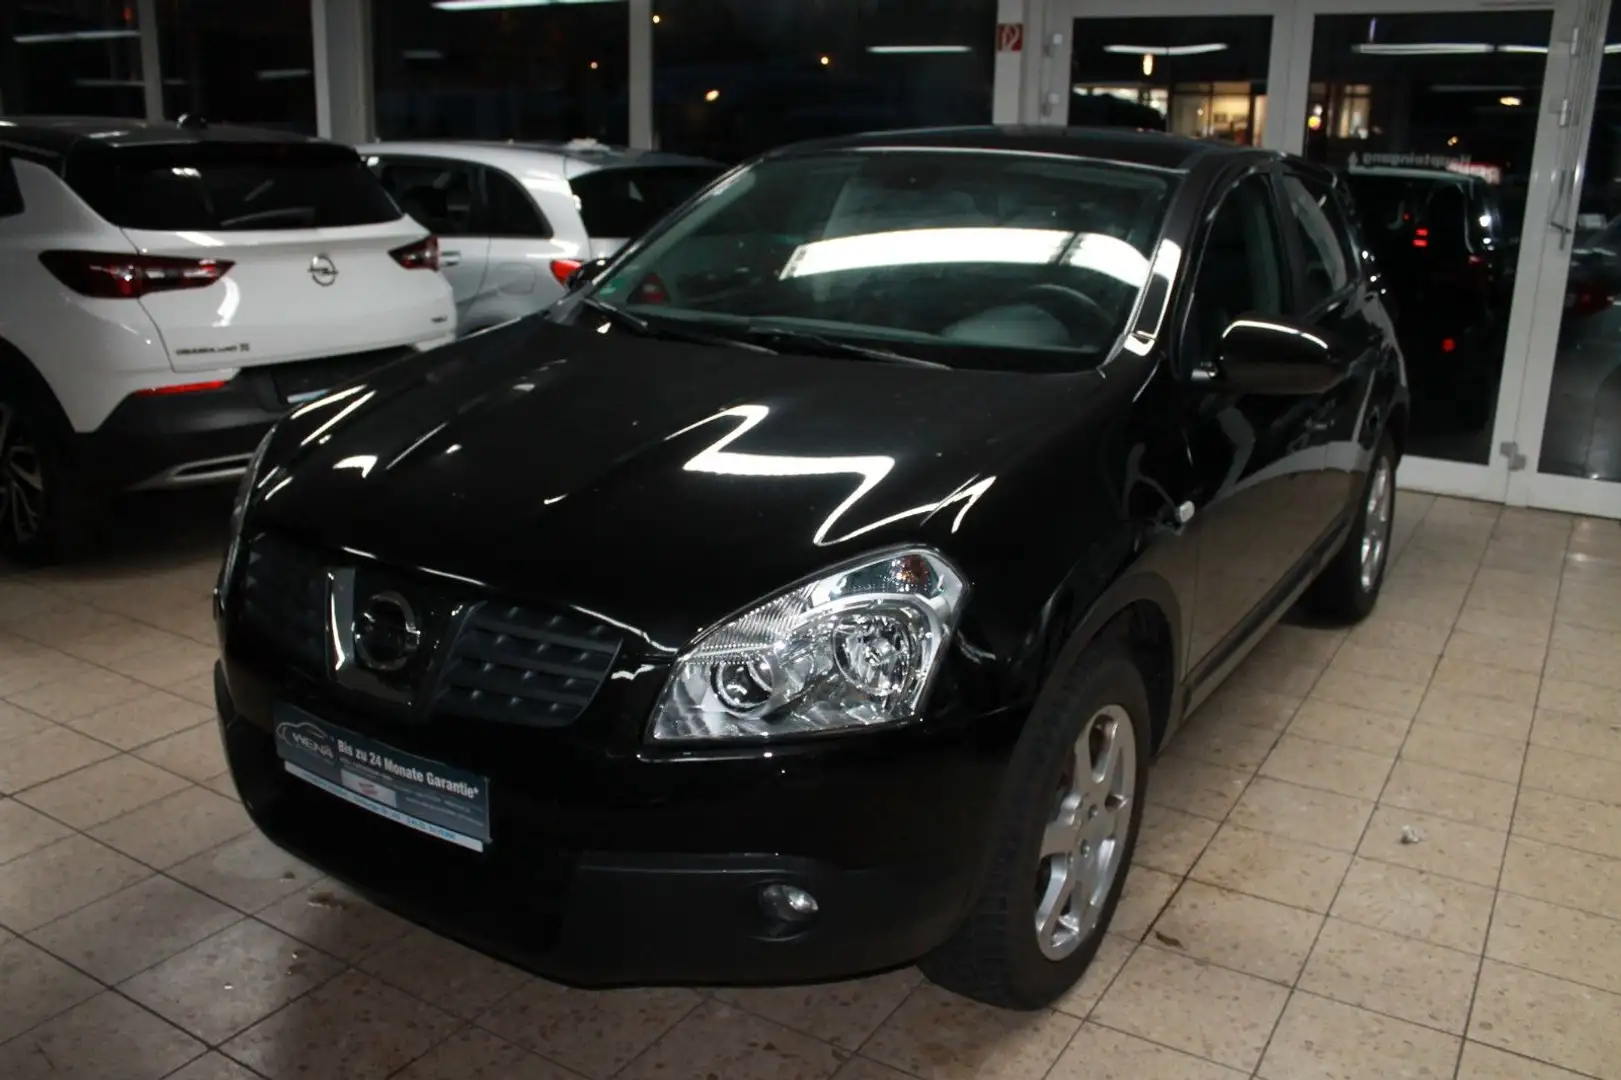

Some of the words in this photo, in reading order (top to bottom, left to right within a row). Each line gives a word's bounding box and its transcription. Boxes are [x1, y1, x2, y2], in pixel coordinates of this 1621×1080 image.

[337, 739, 353, 756] Bis
[355, 748, 367, 762] zu
[369, 752, 382, 768] 24
[384, 757, 424, 782] Monate
